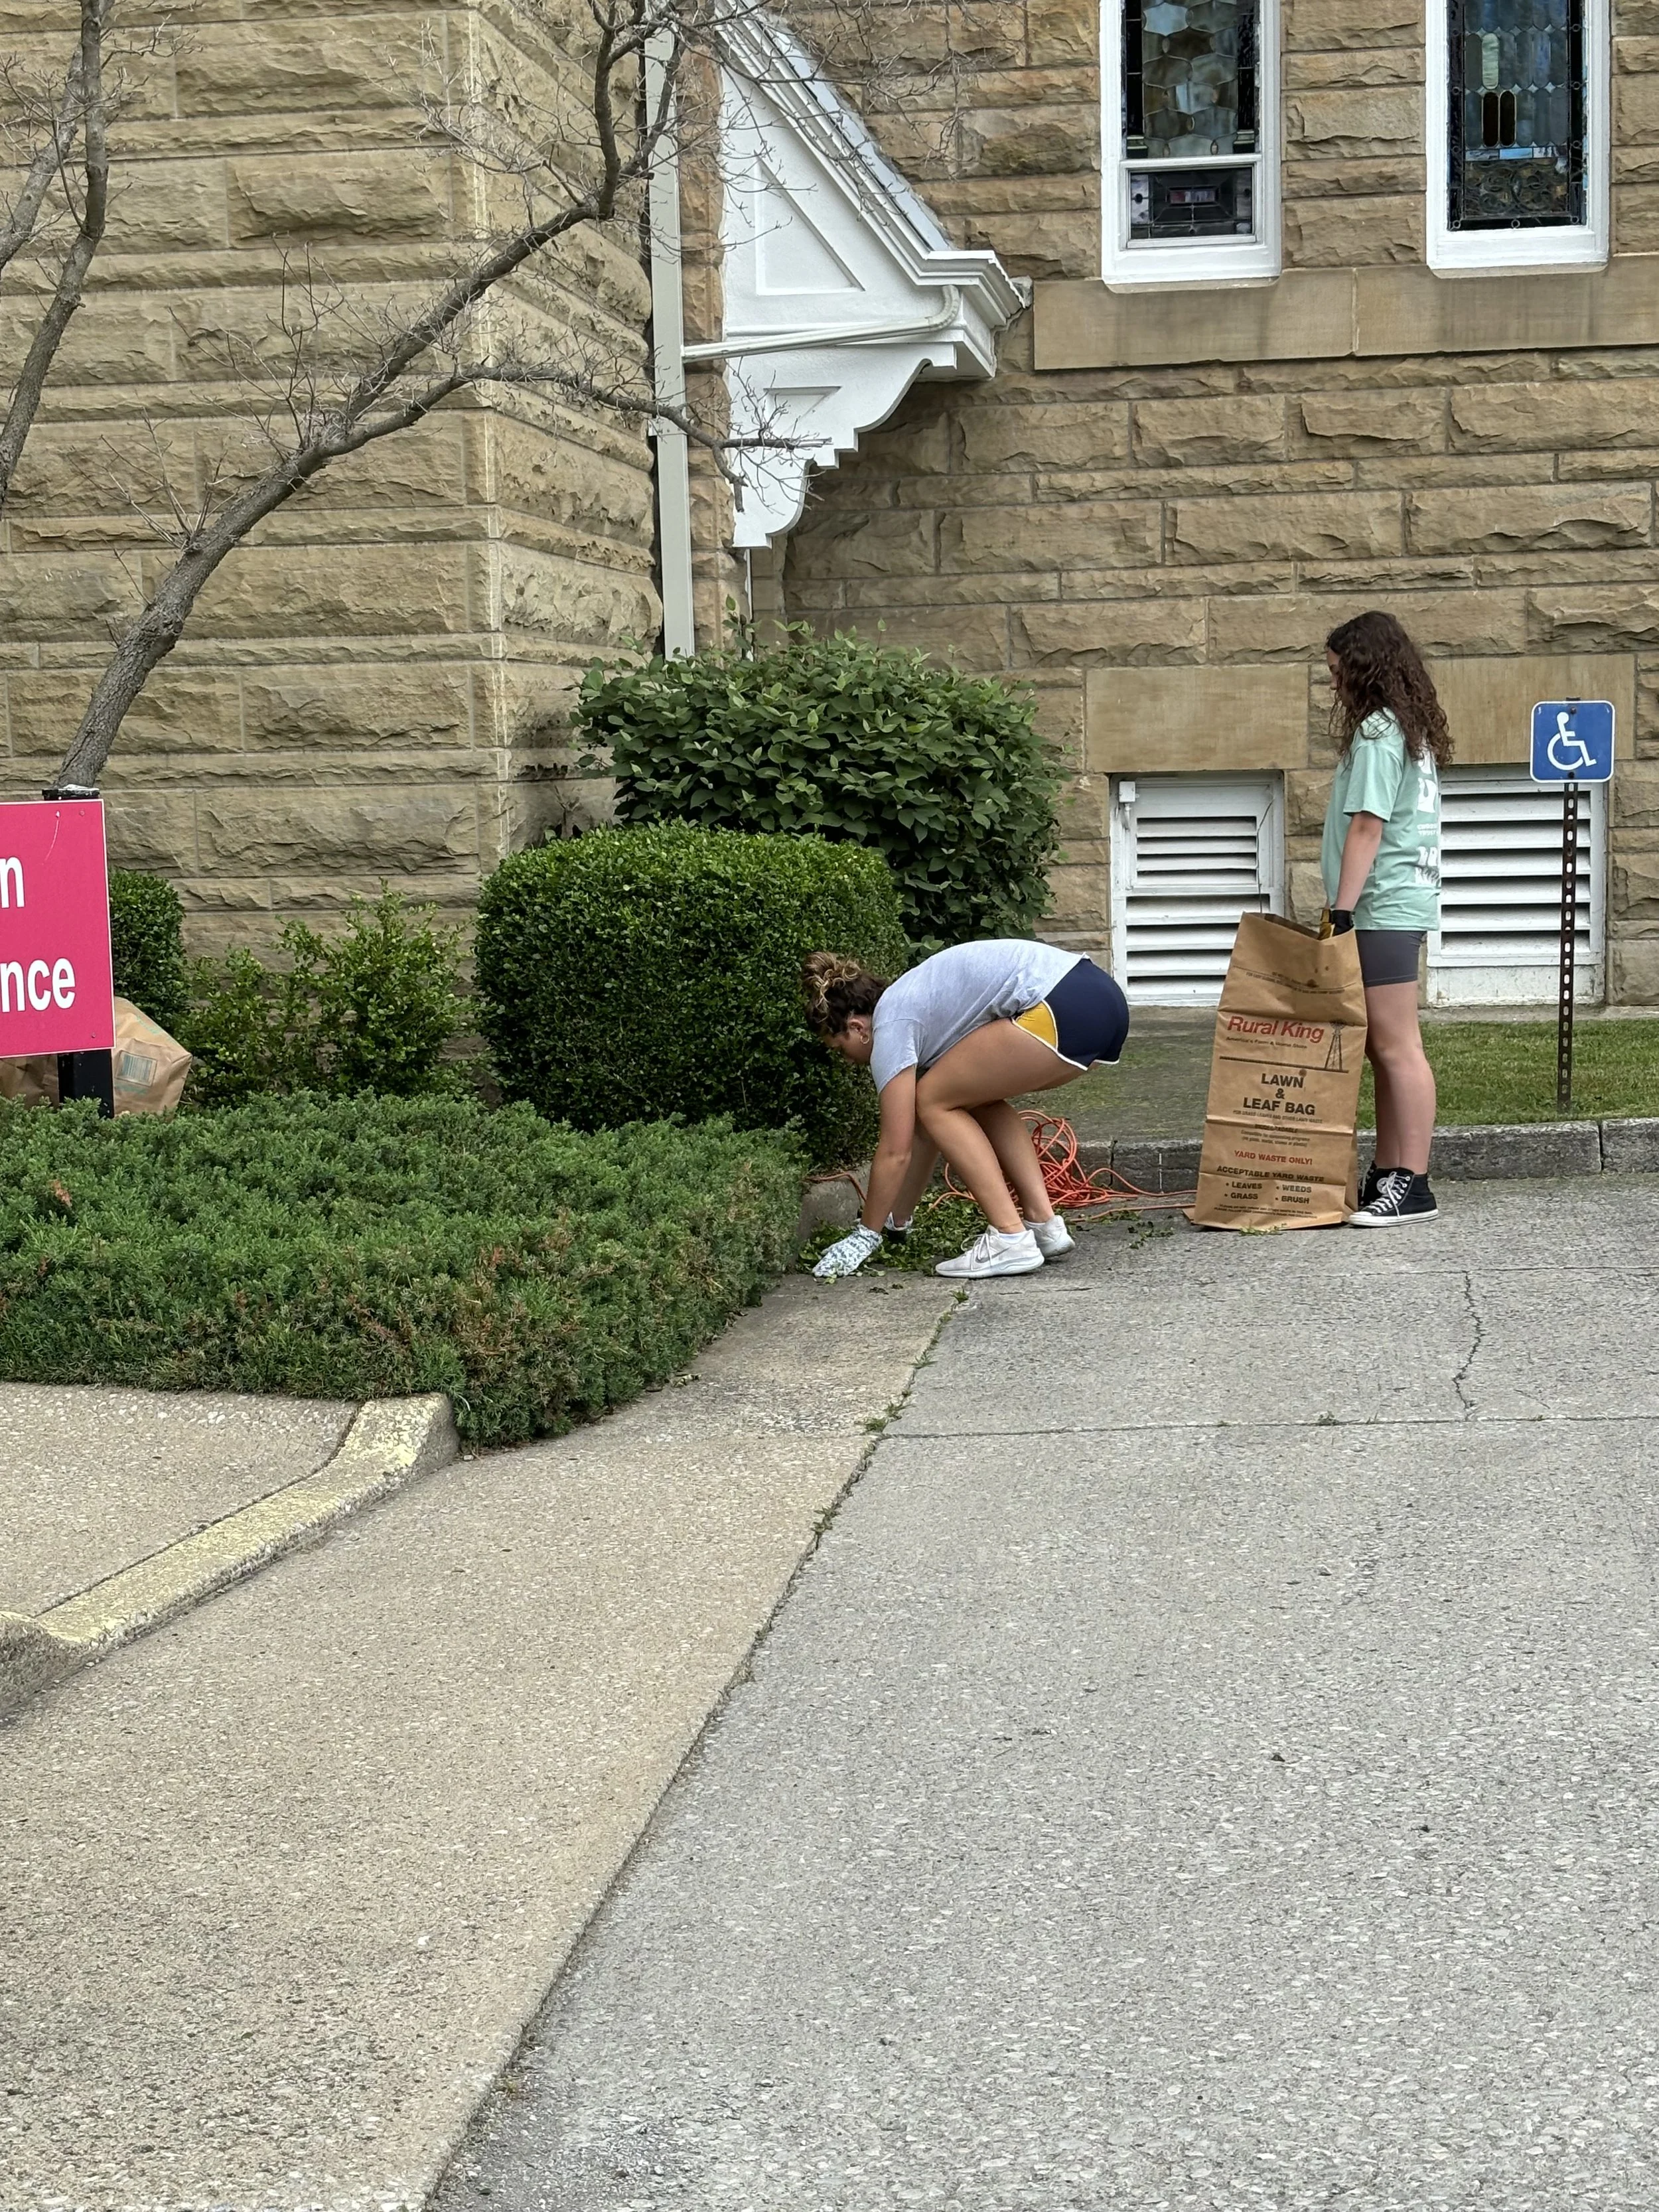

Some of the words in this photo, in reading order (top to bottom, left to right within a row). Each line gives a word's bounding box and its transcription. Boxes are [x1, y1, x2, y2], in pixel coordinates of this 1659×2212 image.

[0, 957, 76, 1013] nce
[1227, 1015, 1279, 1035] Rural
[1281, 1021, 1325, 1044] King
[1261, 1073, 1304, 1088] LAWN
[1275, 1088, 1285, 1099] &
[1243, 1097, 1281, 1112] LEAF
[1284, 1102, 1316, 1116] BAG
[1234, 1150, 1256, 1159] YARD
[1258, 1153, 1286, 1163] WASTE
[1289, 1157, 1313, 1165] ONLY!
[1216, 1165, 1270, 1178] ACCEPTABLE
[1282, 1184, 1312, 1193] WEEDS
[1281, 1195, 1310, 1204] BRUSH
